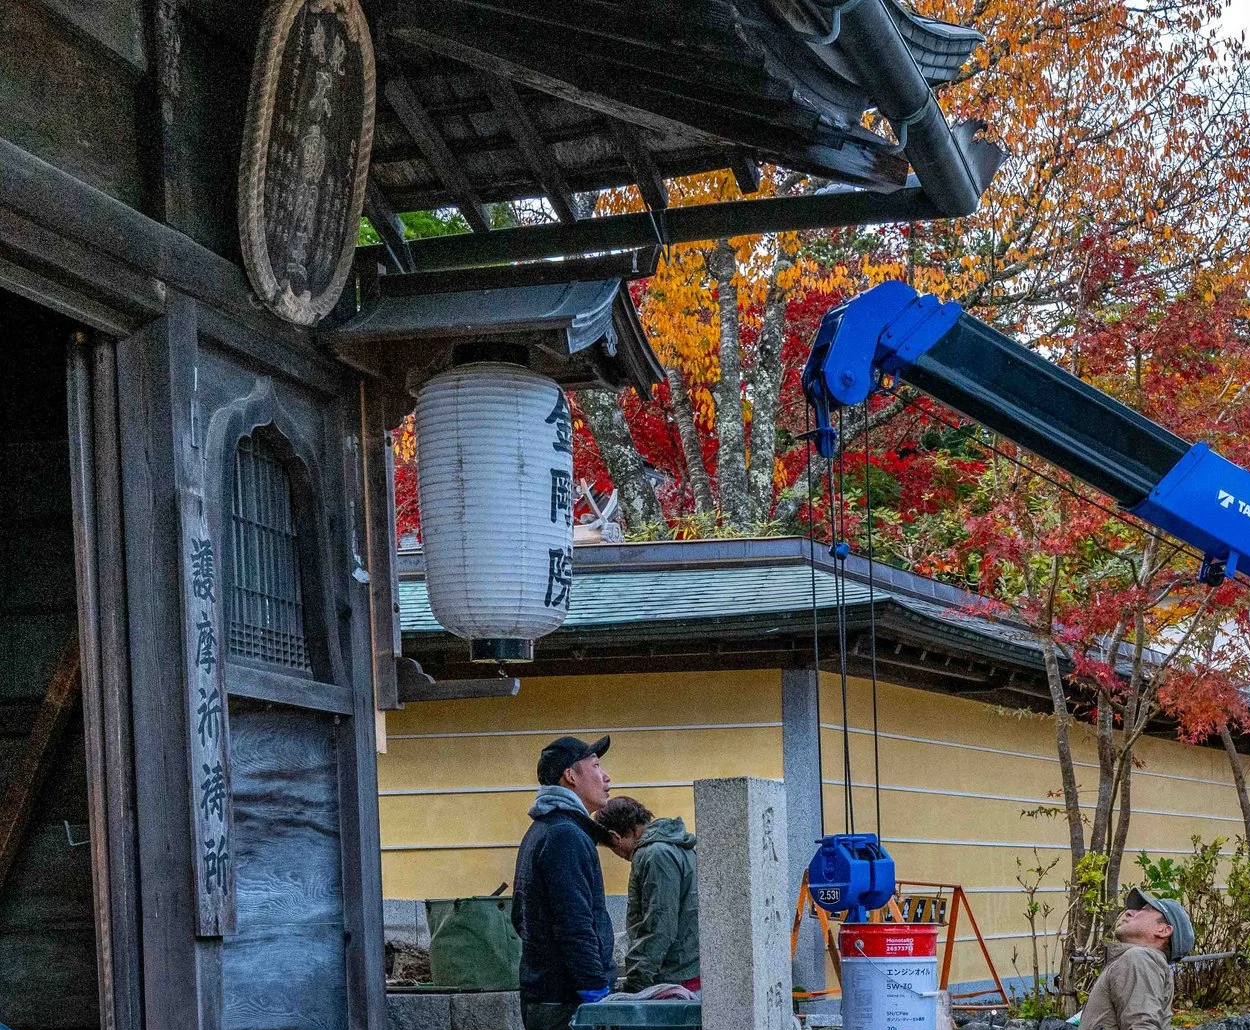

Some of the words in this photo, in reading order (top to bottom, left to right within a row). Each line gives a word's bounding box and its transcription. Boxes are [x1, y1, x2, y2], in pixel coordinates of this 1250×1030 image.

[820, 890, 839, 900] 2.53t
[886, 968, 931, 976] エンジンオイル
